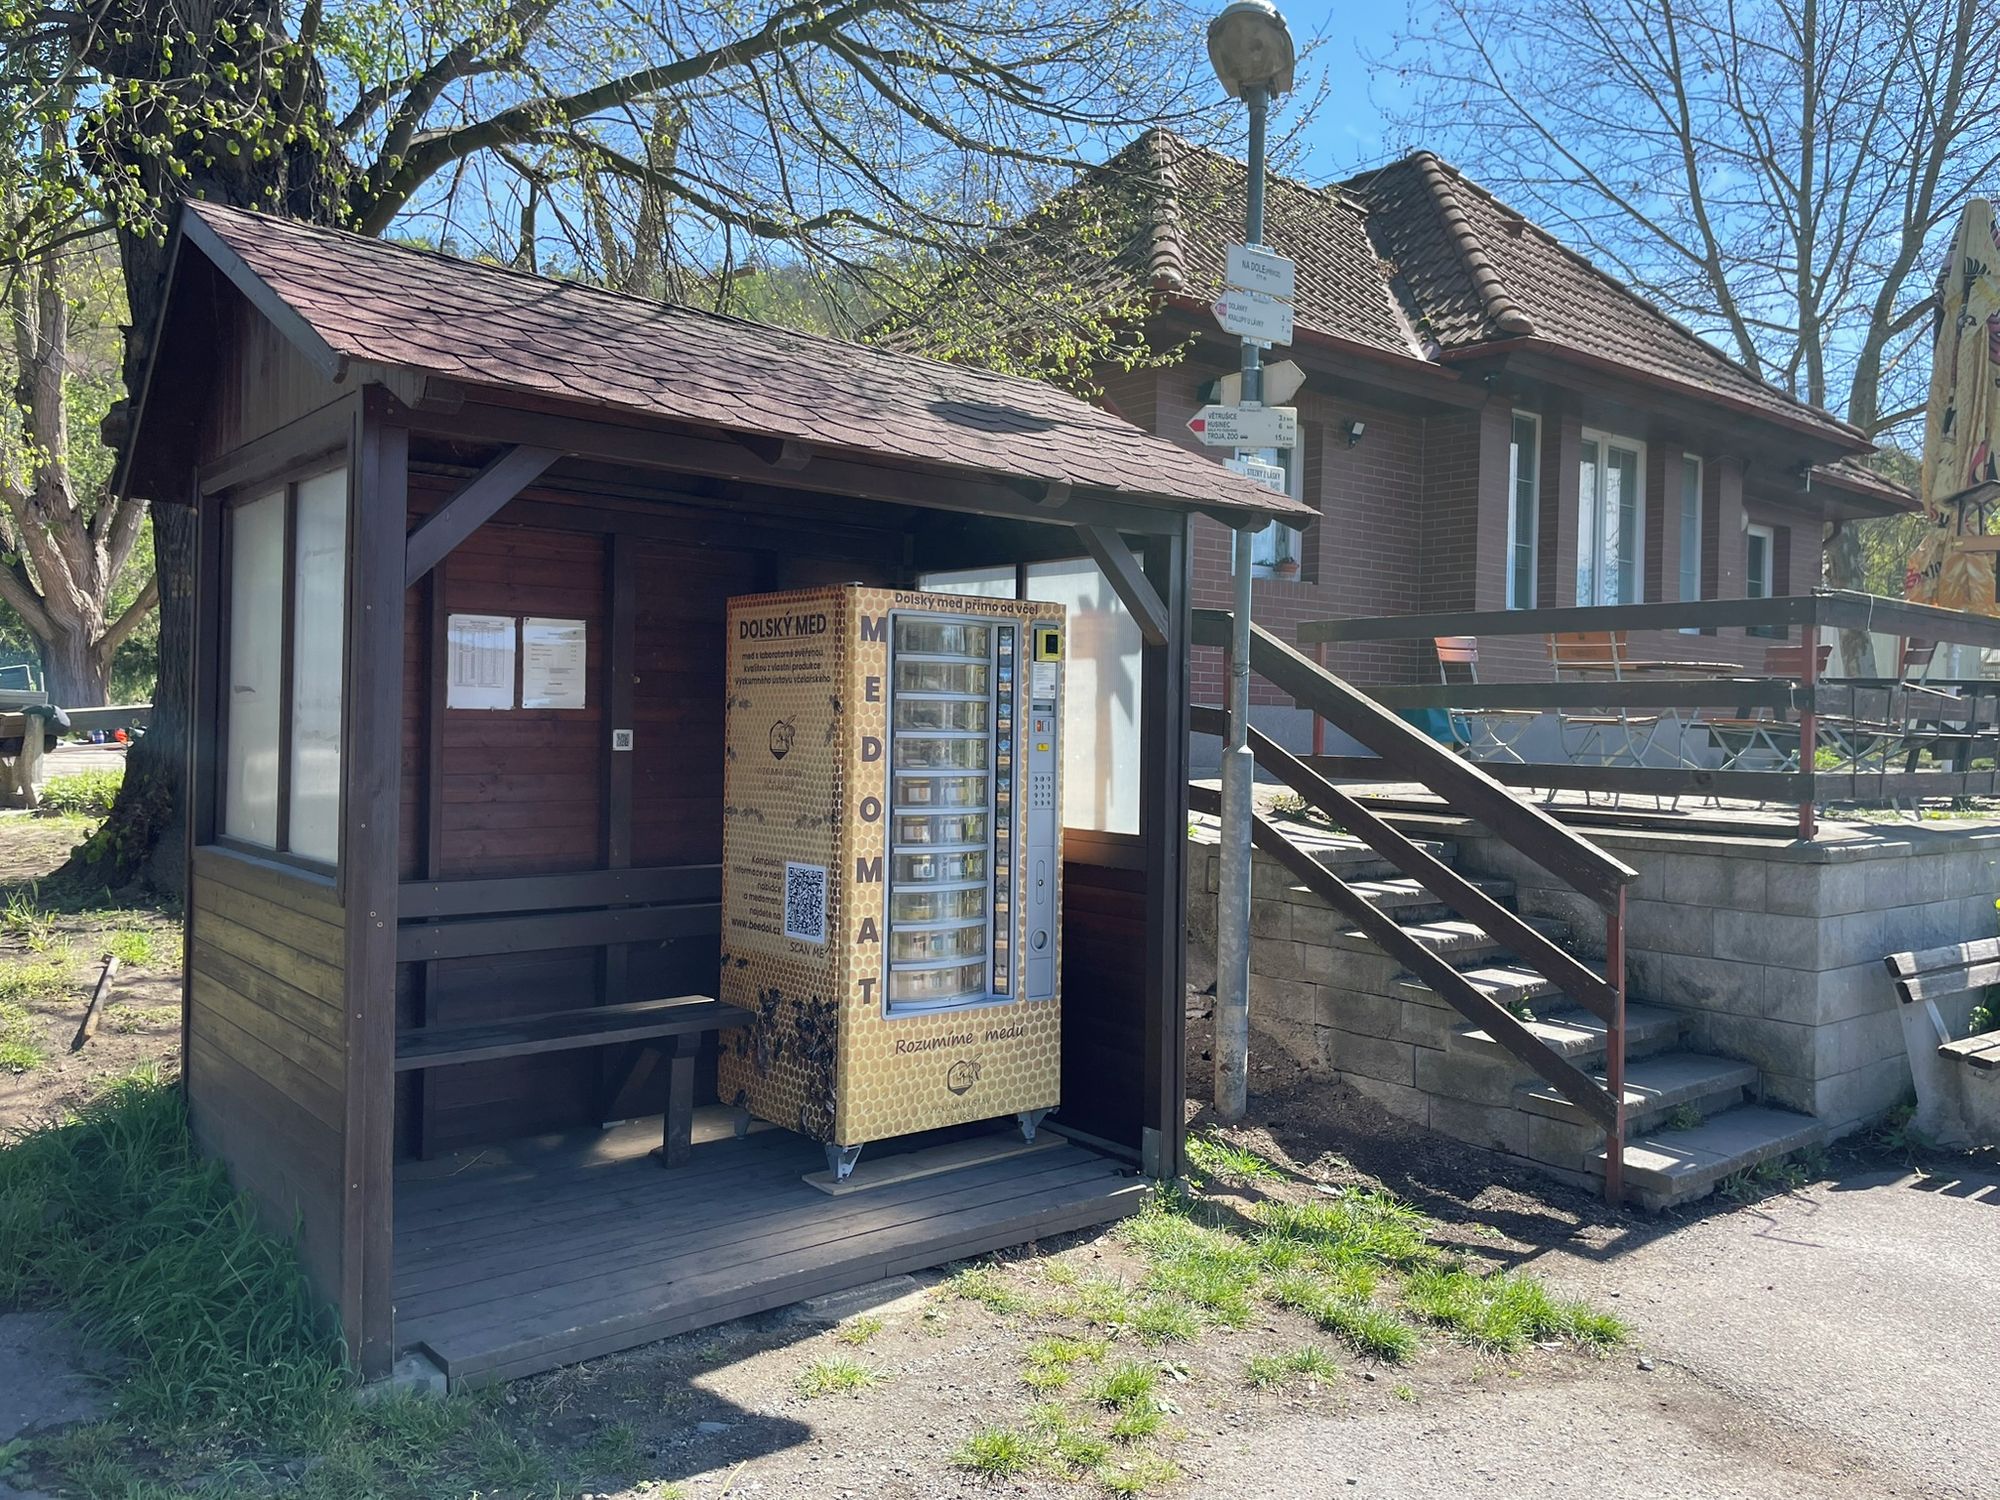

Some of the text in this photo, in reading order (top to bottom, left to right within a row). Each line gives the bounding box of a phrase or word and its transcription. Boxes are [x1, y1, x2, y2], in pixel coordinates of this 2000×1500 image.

[1242, 260, 1250, 270] NA
[1251, 262, 1266, 273] DOLE
[1208, 411, 1237, 420] VĚTRUŠICE
[895, 592, 1038, 615] Dolský med přímo od včel
[740, 609, 826, 640] DOLSKÝ MED
[744, 663, 766, 672] kvalitou
[771, 663, 790, 671] vlastní
[792, 662, 821, 673] produkce
[856, 616, 886, 1004] MEDOMAT
[749, 894, 782, 906] medomatu
[731, 918, 781, 936] www.beedol.cz
[790, 942, 824, 958] SCAN ME
[895, 1023, 1024, 1054] Rozumíme medu
